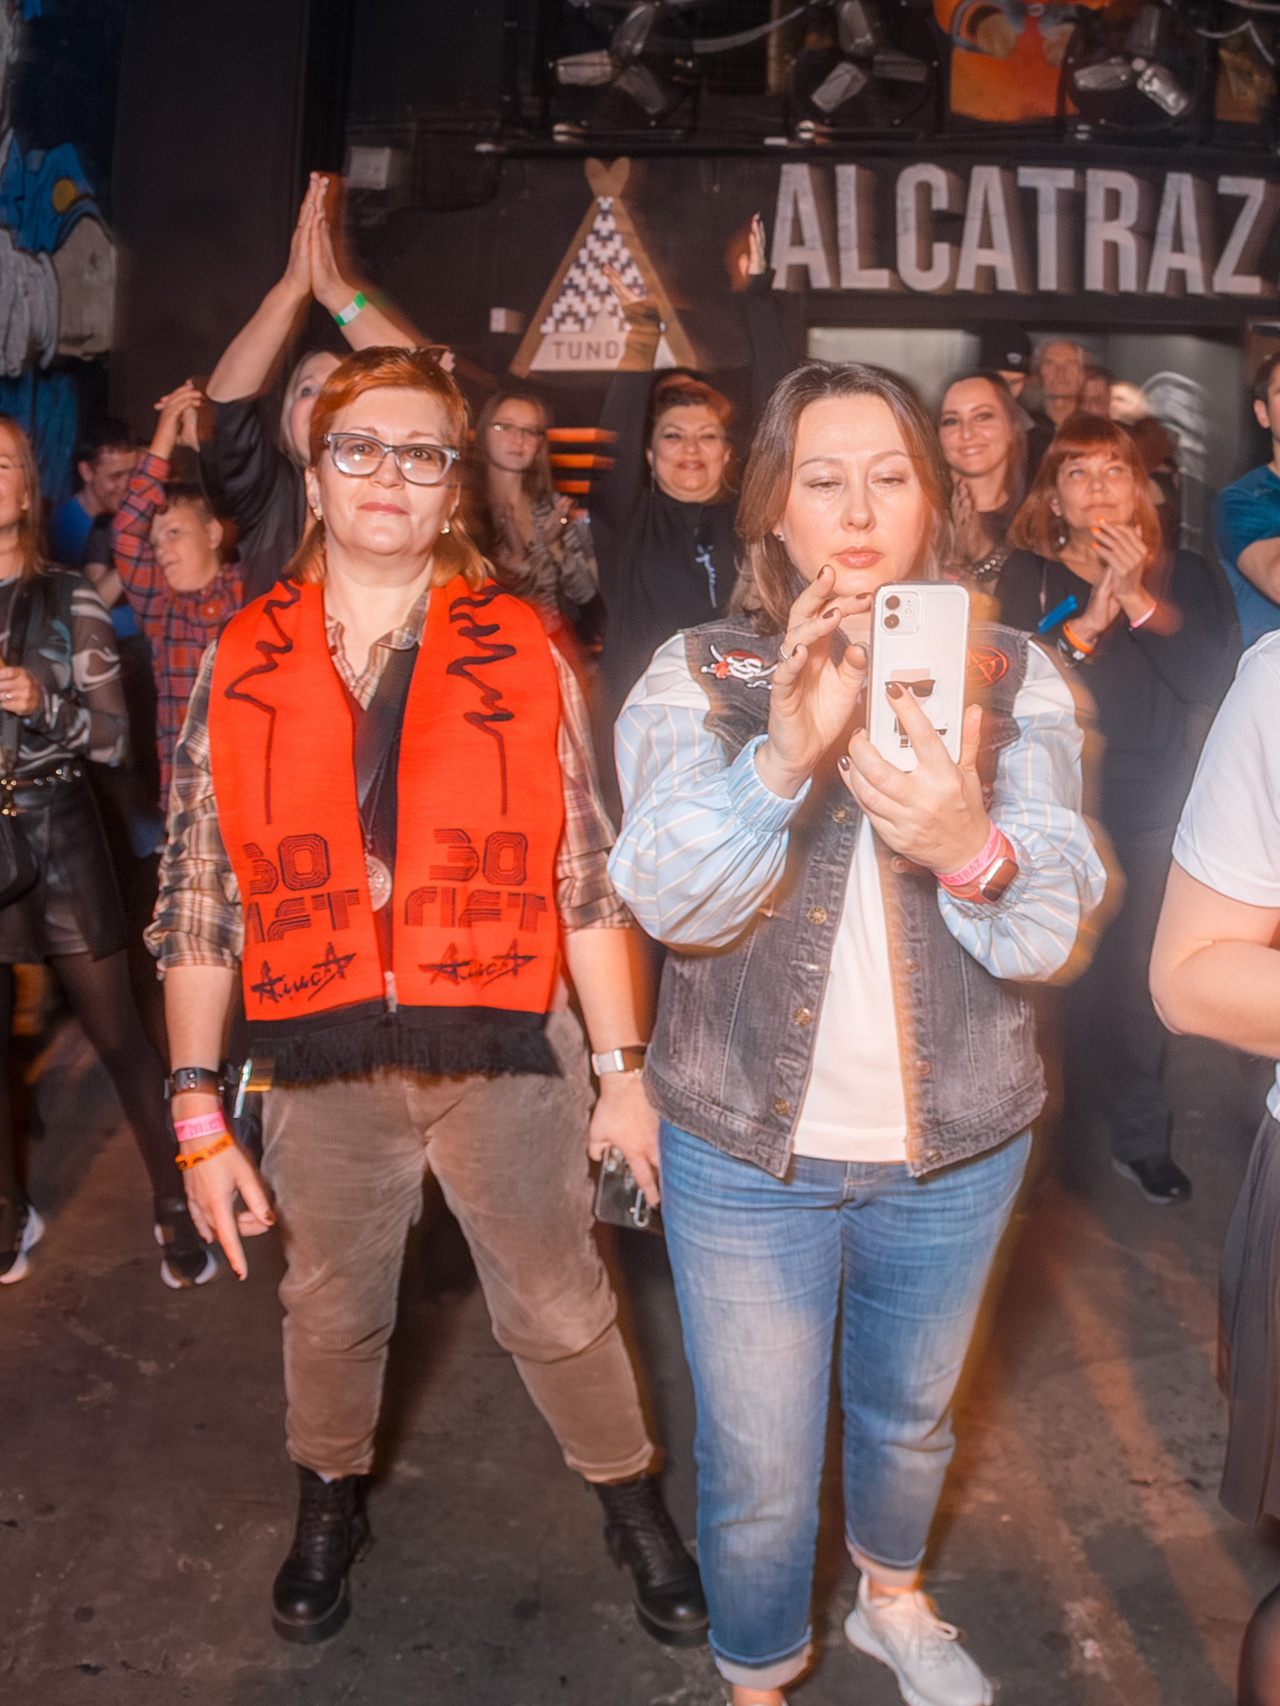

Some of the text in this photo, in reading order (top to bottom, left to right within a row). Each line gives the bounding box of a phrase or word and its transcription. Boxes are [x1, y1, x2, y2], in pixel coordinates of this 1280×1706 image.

[771, 163, 1266, 295] ALCATRAZ
[552, 340, 620, 361] TUND
[429, 828, 528, 886] 30
[404, 886, 547, 933] ЛЕТ
